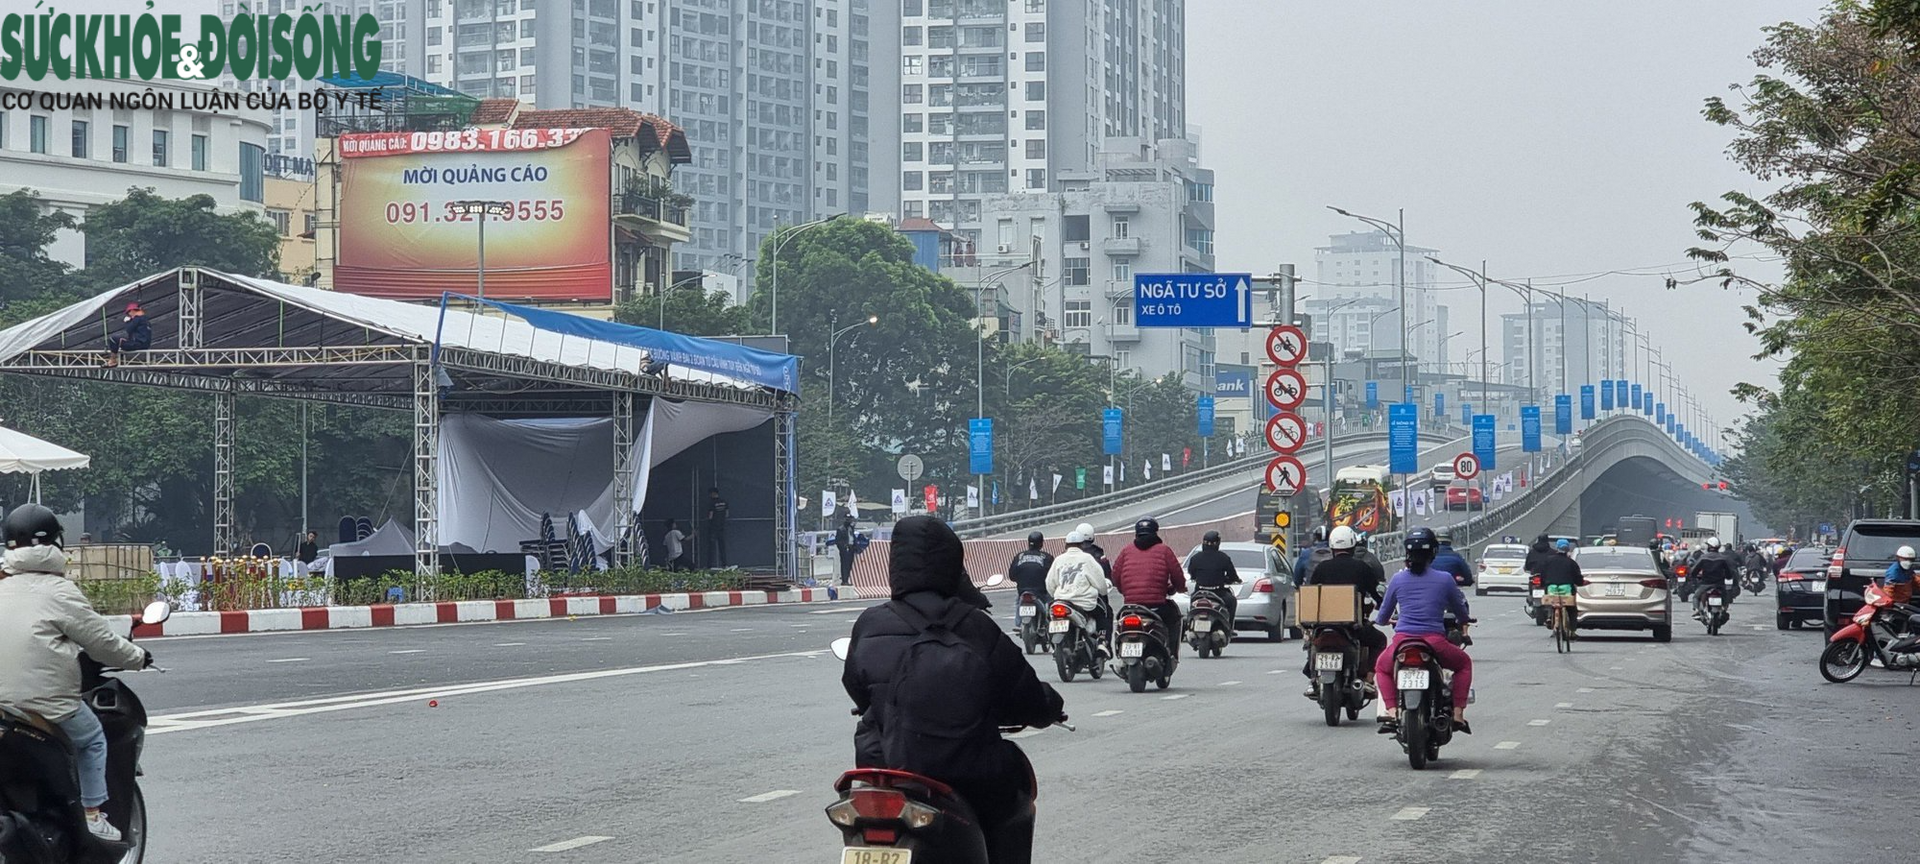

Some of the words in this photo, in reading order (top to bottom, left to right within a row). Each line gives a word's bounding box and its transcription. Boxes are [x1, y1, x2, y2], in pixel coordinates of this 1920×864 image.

[343, 137, 358, 152] MỜI
[359, 135, 387, 153] QUẢNG
[403, 166, 437, 184] MỜI
[442, 164, 506, 185] QUẢNG
[510, 165, 548, 183] CÁO
[1140, 280, 1175, 299] NGÃ
[1177, 282, 1201, 299] TƯ
[1203, 277, 1227, 299] SỞ
[1141, 305, 1156, 315] XE
[1157, 303, 1165, 315] Ô
[1167, 303, 1181, 315] TÔ
[1215, 378, 1245, 391] ank
[1460, 460, 1472, 473] 80
[1402, 679, 1424, 688] 2315
